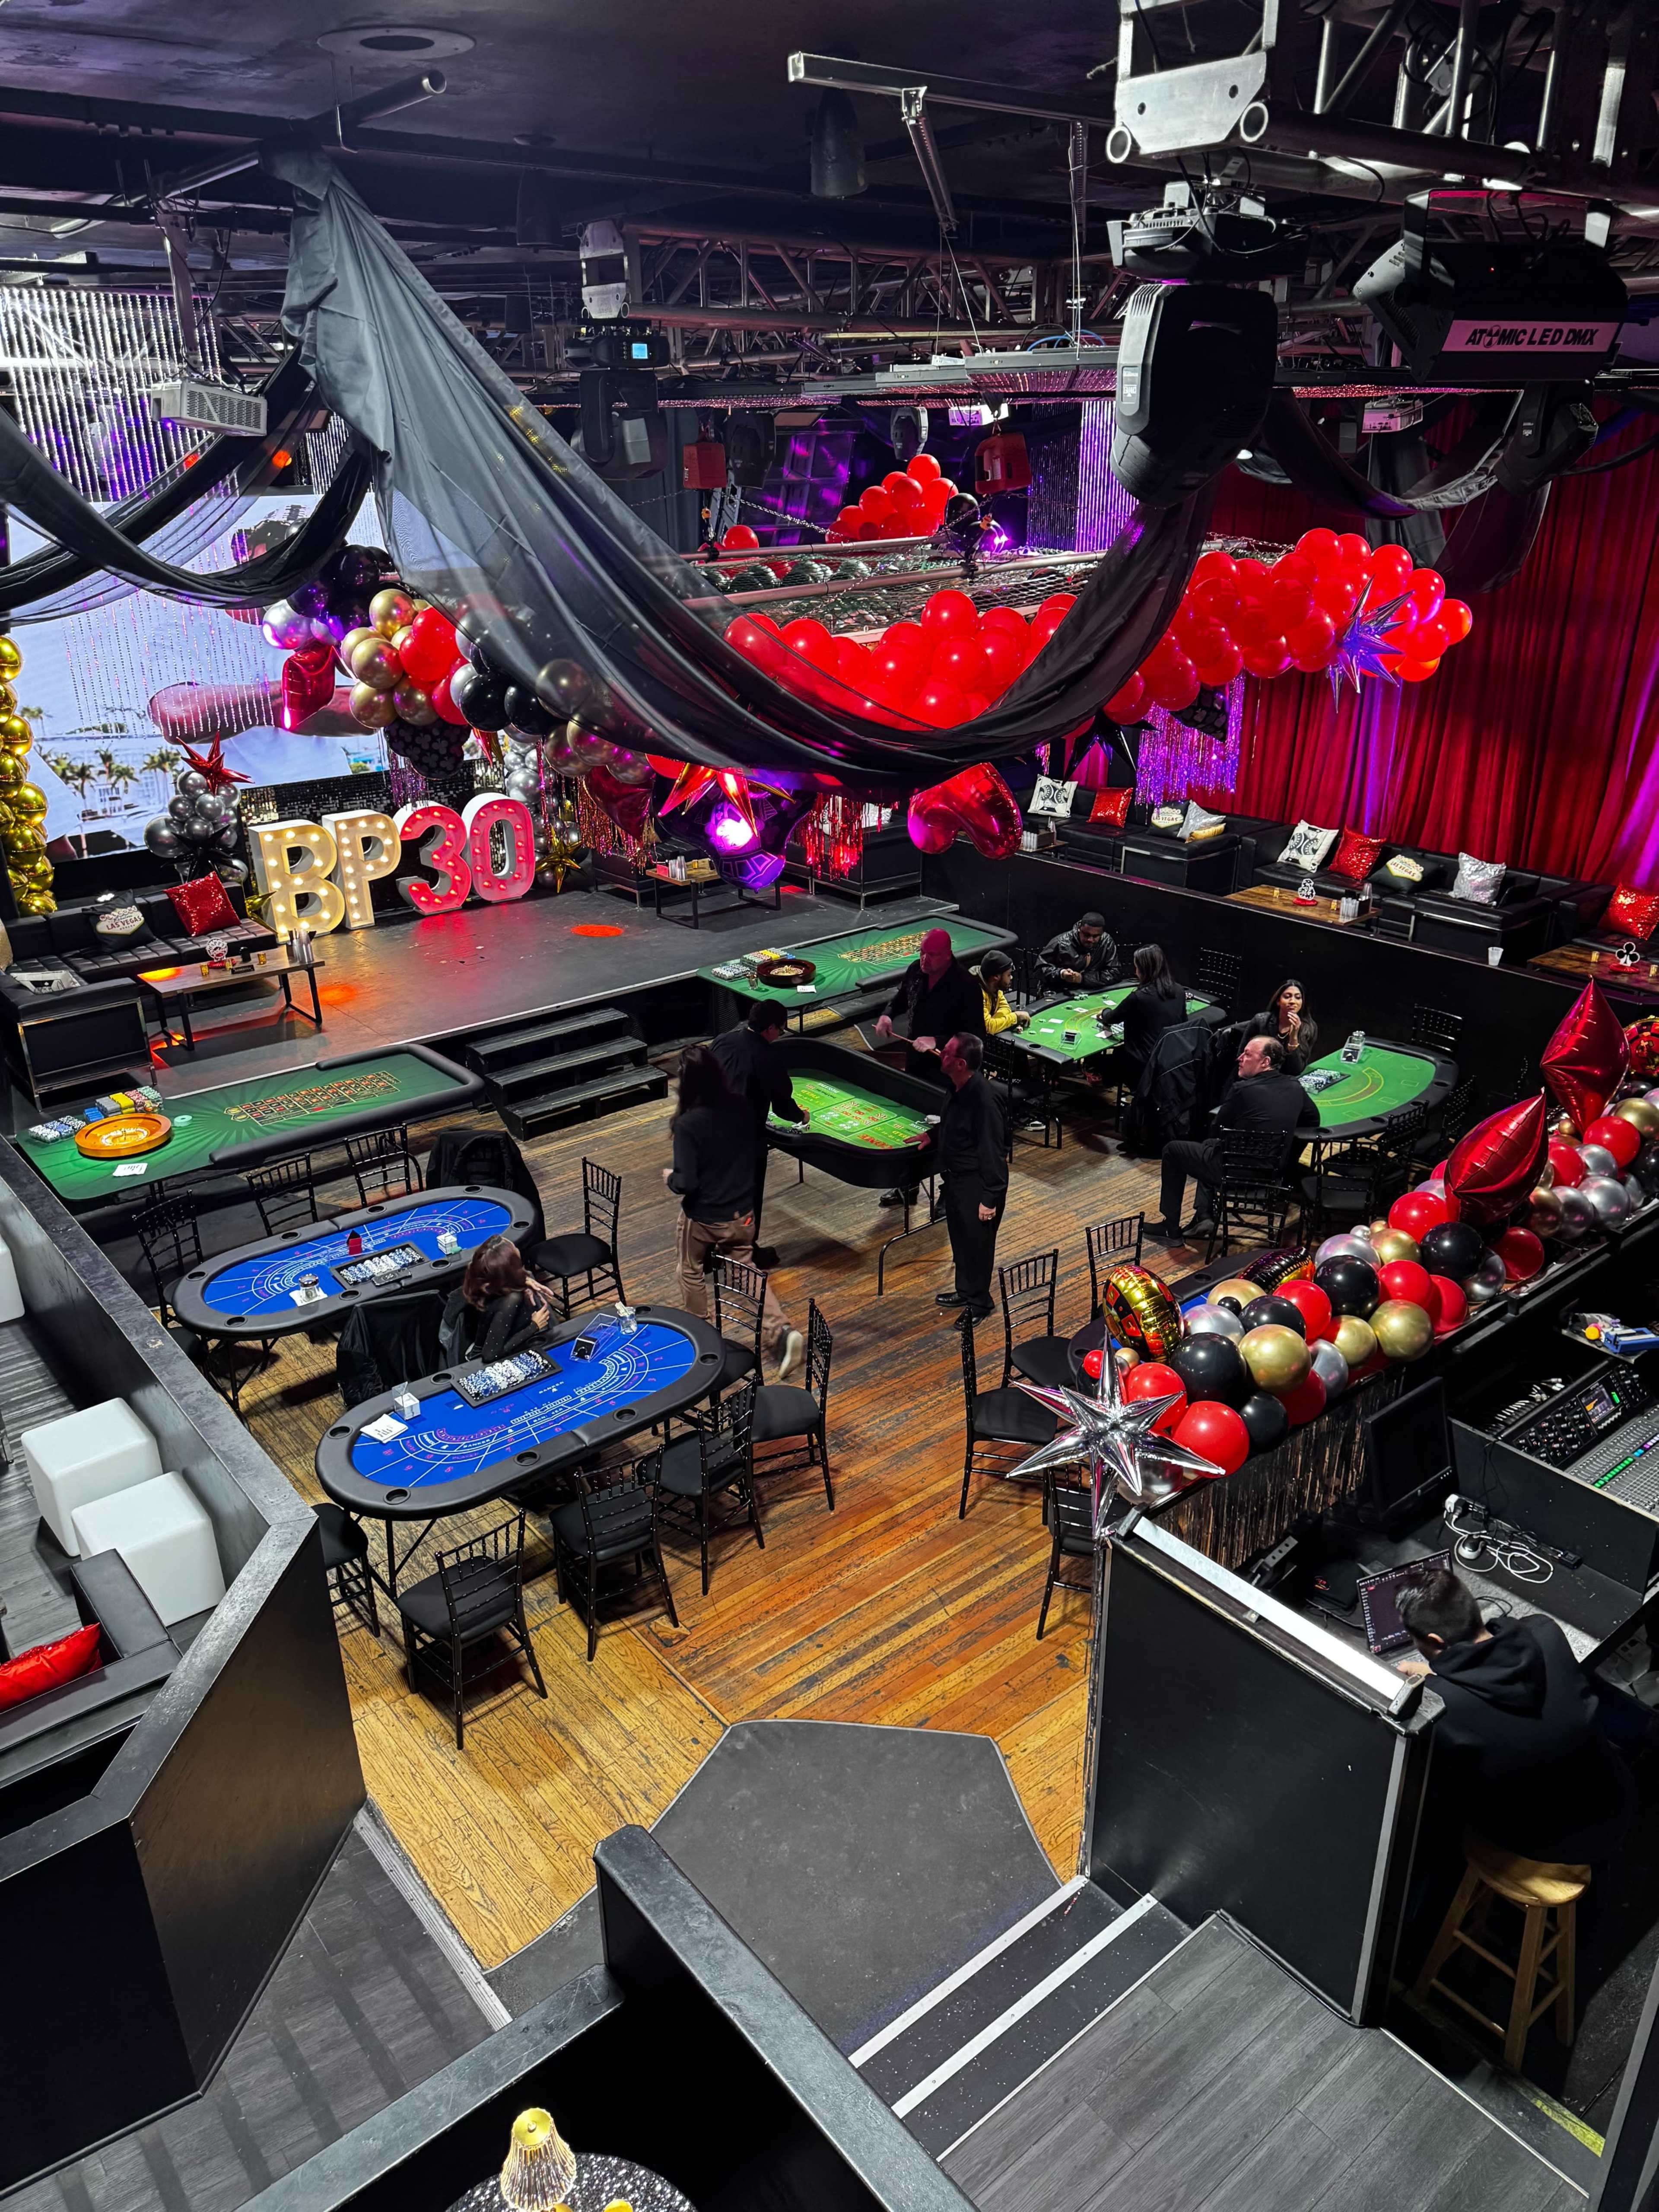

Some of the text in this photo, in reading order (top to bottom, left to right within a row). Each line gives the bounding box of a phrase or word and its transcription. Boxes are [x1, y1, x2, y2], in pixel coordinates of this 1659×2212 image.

[1465, 325, 1599, 348] ATOMIC LED DMX
[121, 916, 142, 926] VEGAS
